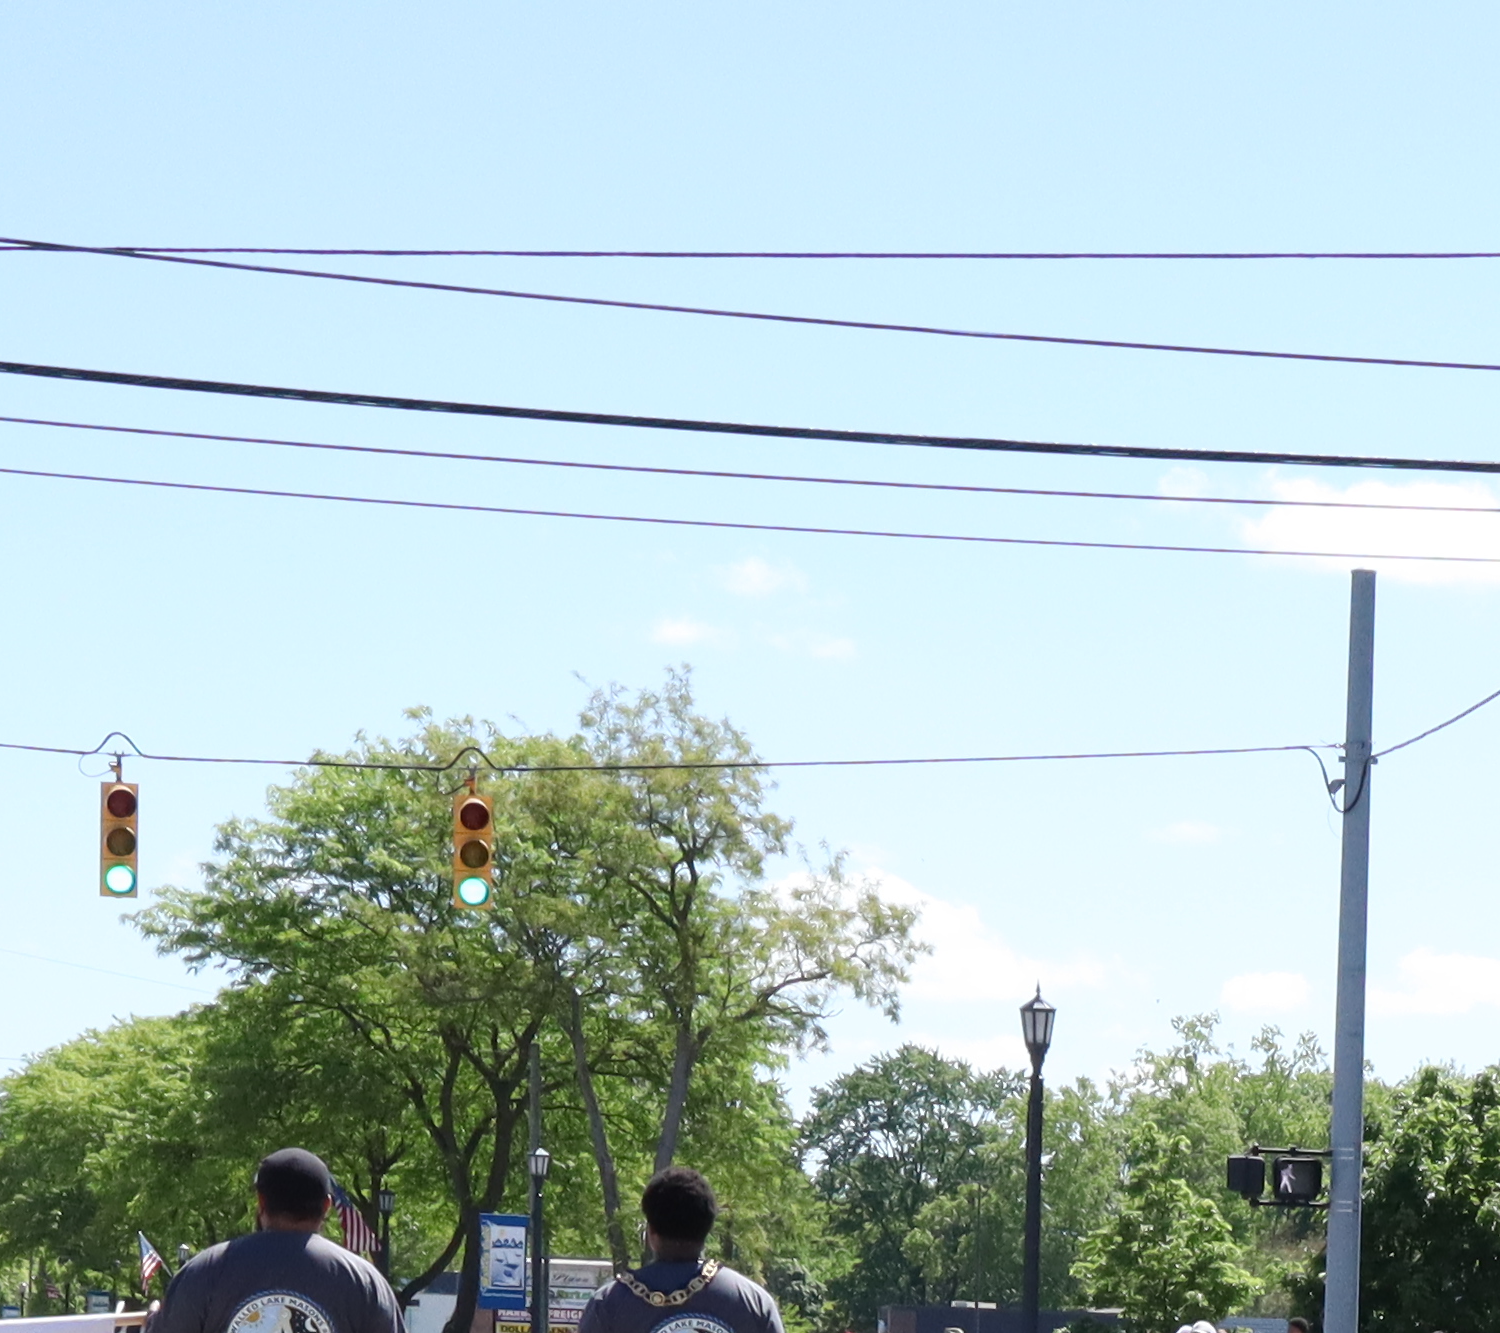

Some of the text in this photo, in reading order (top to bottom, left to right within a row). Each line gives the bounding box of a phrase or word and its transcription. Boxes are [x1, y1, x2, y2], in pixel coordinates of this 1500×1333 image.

[260, 1296, 286, 1307] LAKE
[288, 1297, 325, 1327] MASONS
[668, 1319, 693, 1332] LAKE
